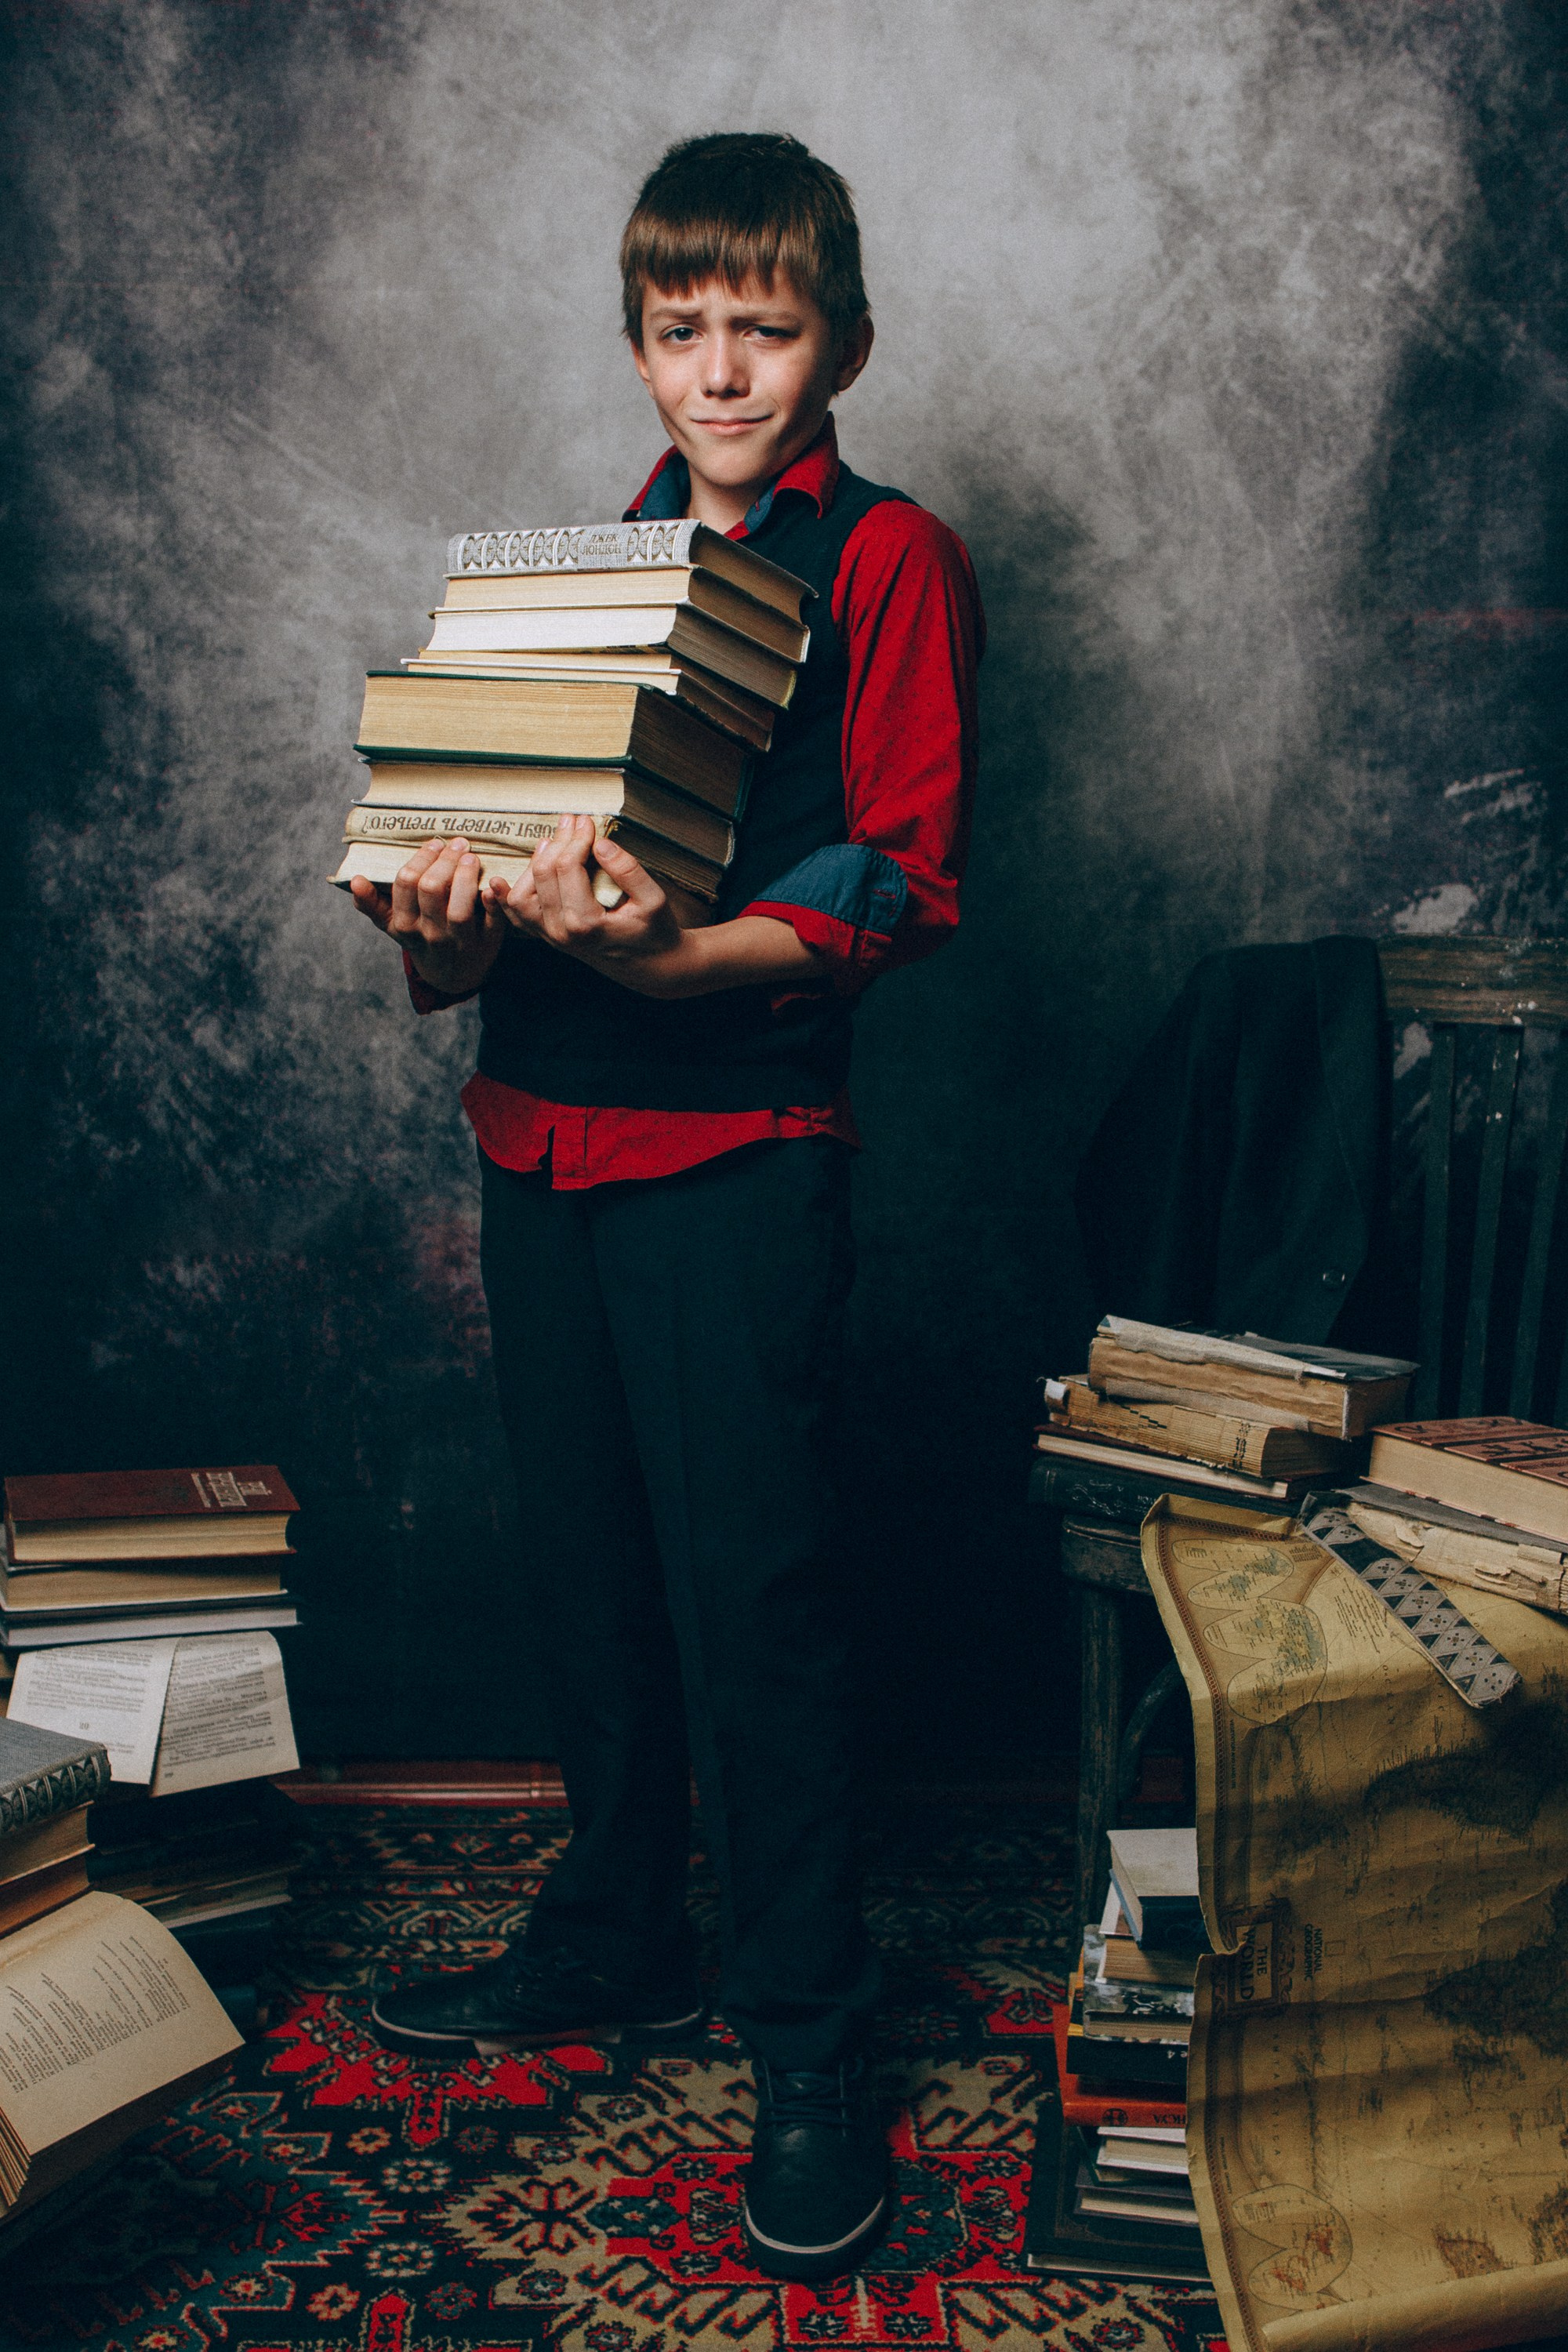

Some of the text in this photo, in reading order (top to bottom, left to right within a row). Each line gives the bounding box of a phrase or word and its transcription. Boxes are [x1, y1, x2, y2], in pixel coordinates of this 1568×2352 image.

[581, 543, 622, 556] ЛОНДОН
[589, 533, 619, 543] ДЖЕК
[1240, 1926, 1256, 2001] WORLD
[1257, 1945, 1268, 1976] THE
[1303, 1923, 1314, 1983] GEOGRAPHIC
[1313, 1928, 1323, 1974] NATIONAL
